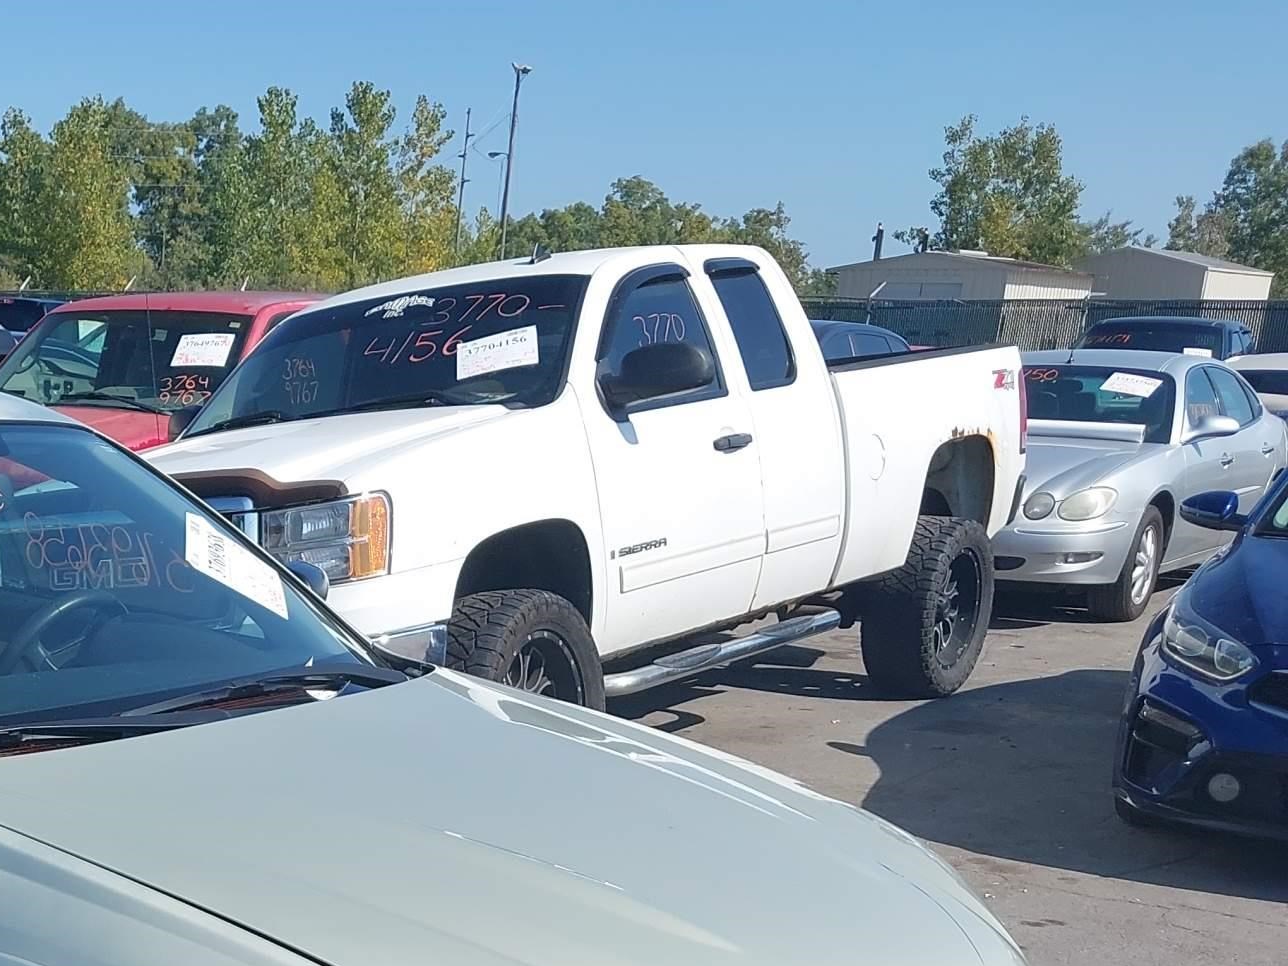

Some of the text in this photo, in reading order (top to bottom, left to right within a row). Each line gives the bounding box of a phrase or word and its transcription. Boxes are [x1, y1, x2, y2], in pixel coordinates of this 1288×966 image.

[364, 324, 472, 365] 4156
[159, 374, 209, 391] 3764
[159, 390, 212, 405] 9767
[618, 537, 668, 557] SIERRA
